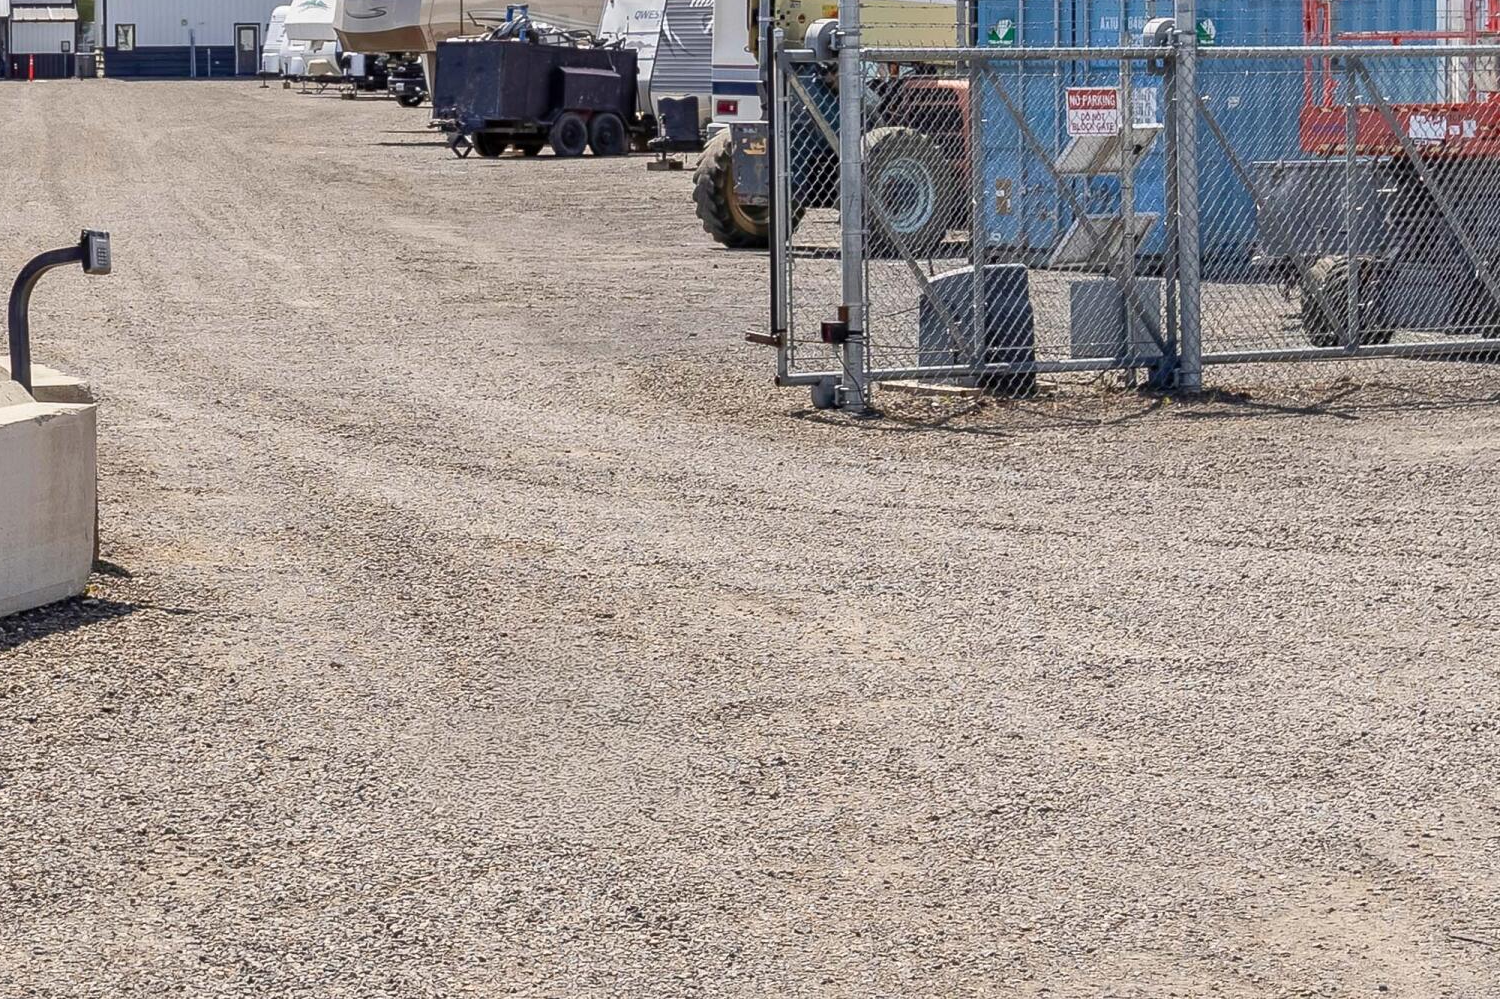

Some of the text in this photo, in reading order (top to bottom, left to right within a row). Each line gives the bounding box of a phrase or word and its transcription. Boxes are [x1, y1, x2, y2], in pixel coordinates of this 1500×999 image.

[1069, 94, 1116, 106] NO PARKING
[1080, 111, 1105, 121] DO NOT
[1072, 122, 1115, 131] BLOCK GATE
